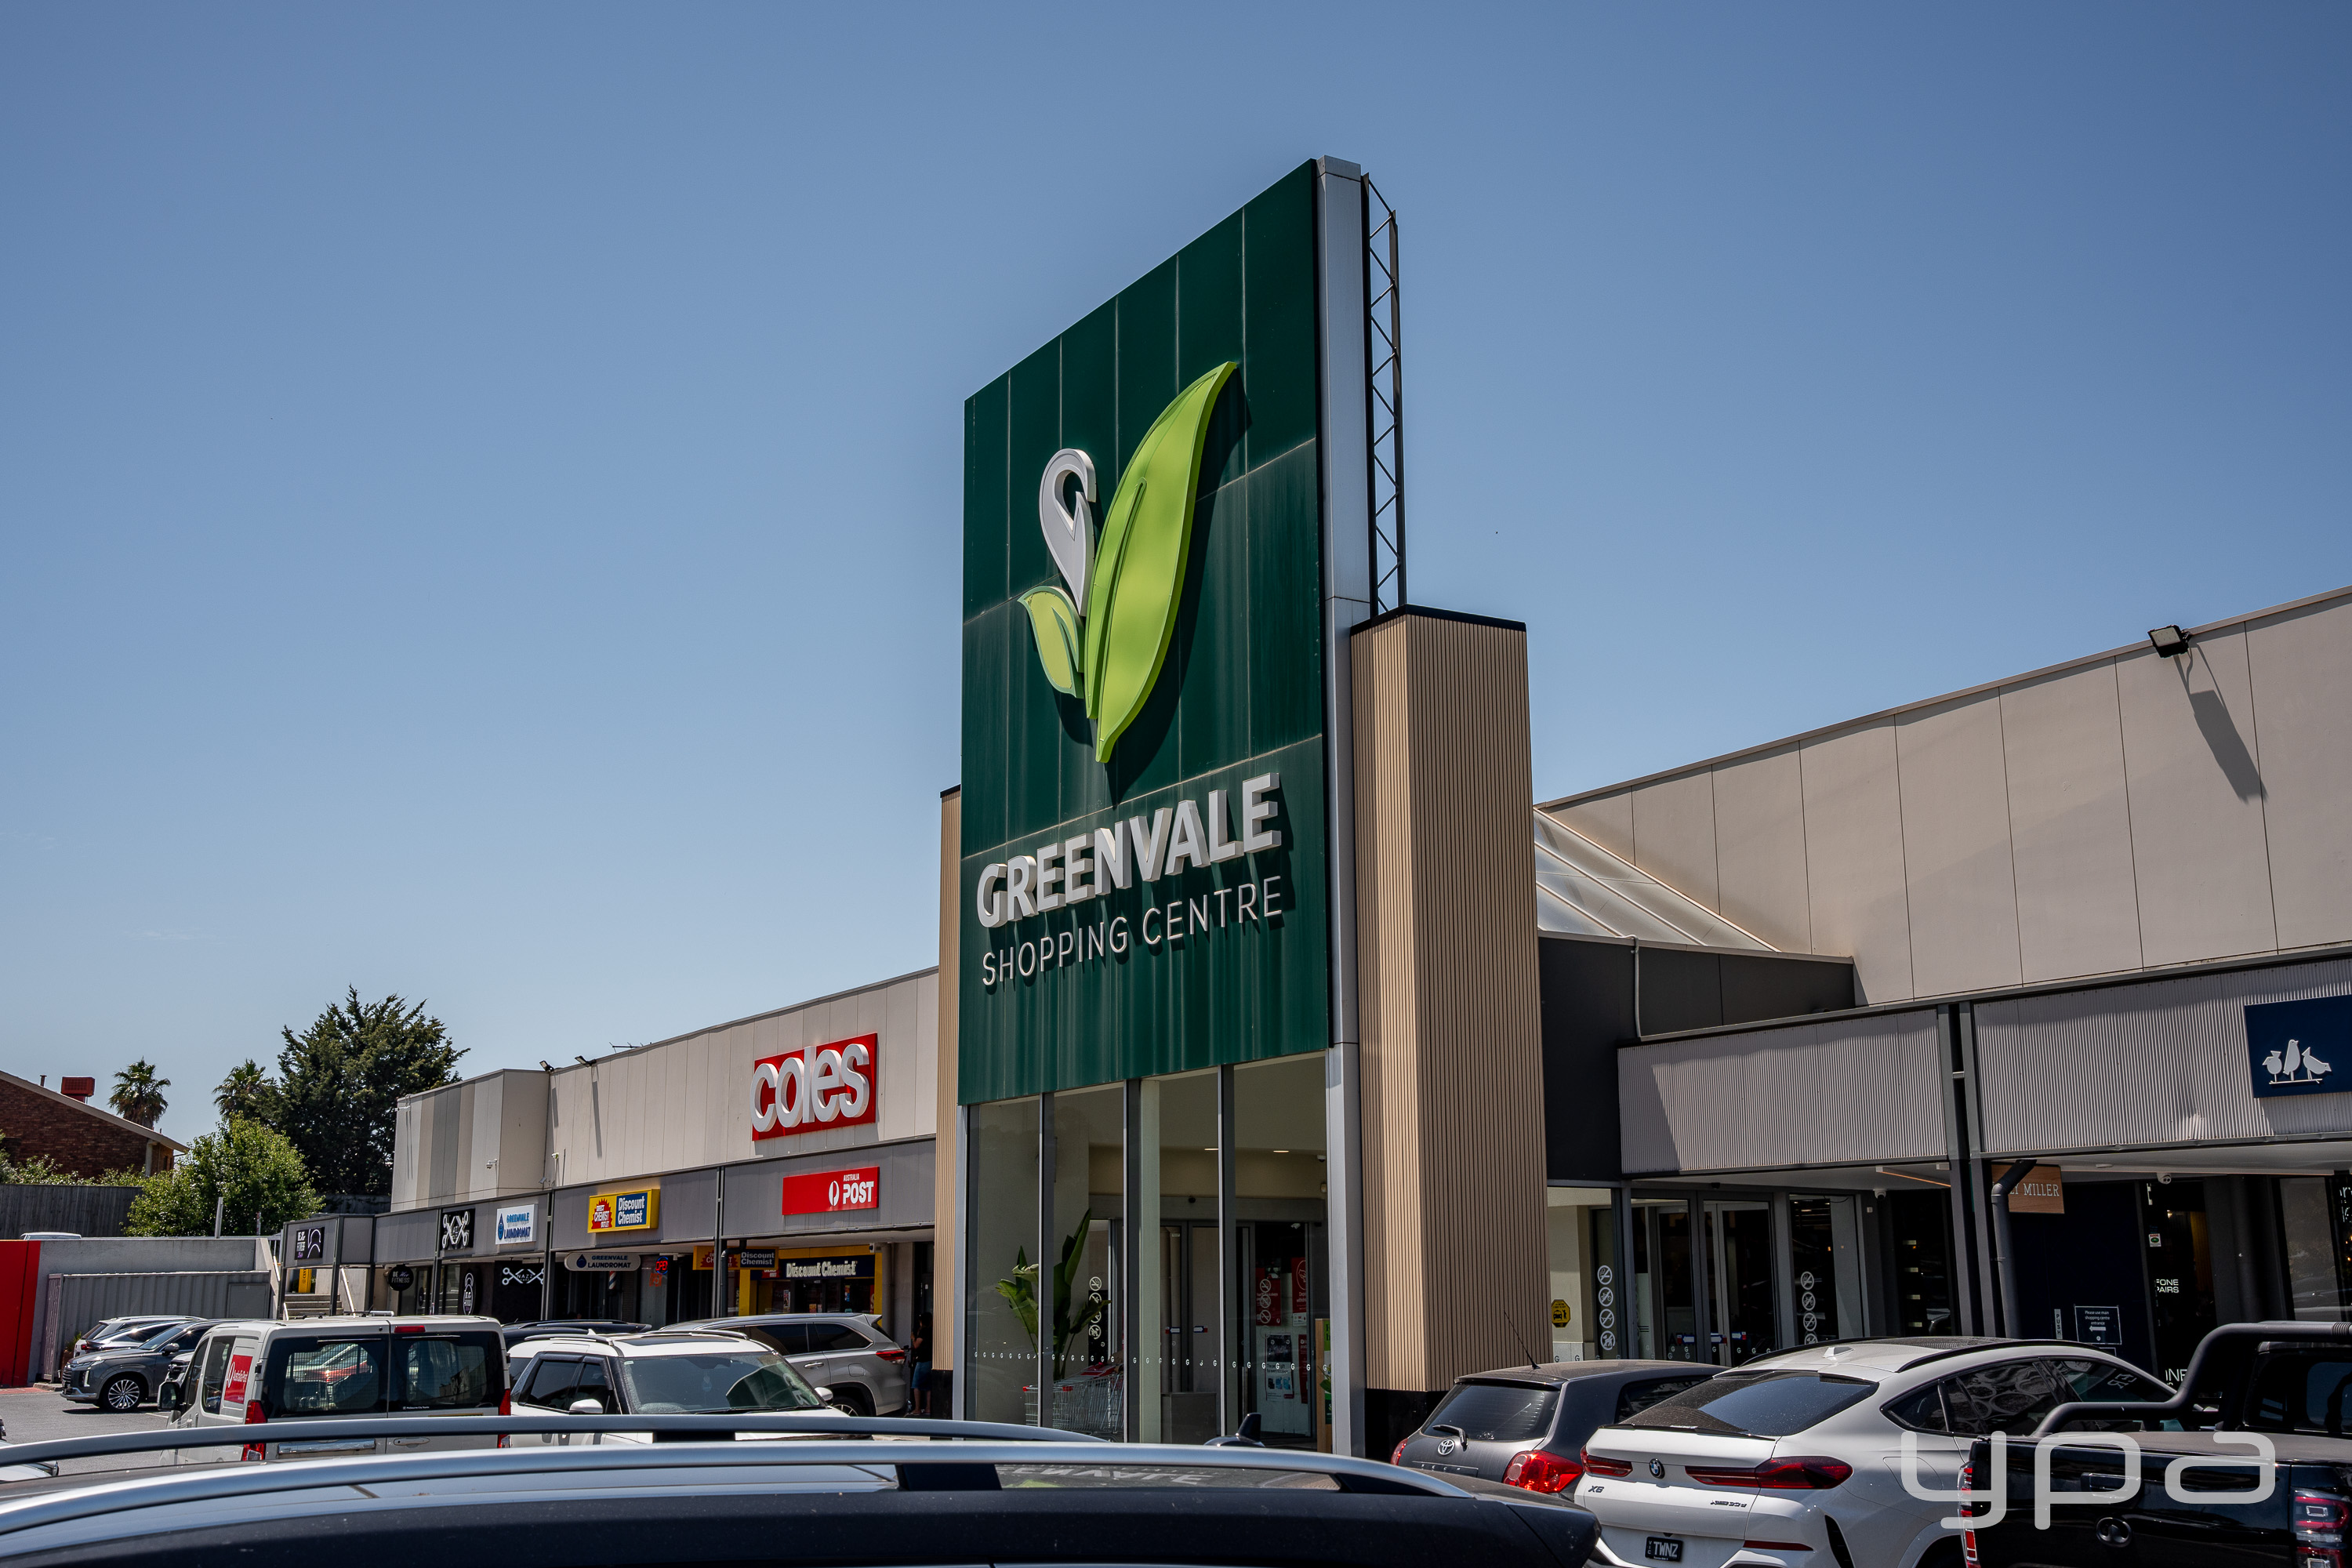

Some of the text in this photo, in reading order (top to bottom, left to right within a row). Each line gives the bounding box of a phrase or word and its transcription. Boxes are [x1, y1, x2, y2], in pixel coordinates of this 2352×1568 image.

[977, 773, 1282, 928] GREENVALE
[982, 876, 1282, 985] SHOPPING CENTRE
[750, 1044, 870, 1132] coles
[843, 1173, 860, 1181] AUSTRALIA
[843, 1181, 874, 1204] POST
[2023, 1183, 2060, 1196] MILLER
[618, 1196, 645, 1211] Discount
[506, 1212, 530, 1223] GREENVALE
[593, 1210, 610, 1222] CHEMIST
[618, 1210, 643, 1225] Chemist
[786, 1262, 822, 1278] Discount
[822, 1260, 856, 1277] Chemist
[1653, 1541, 1679, 1558] TWNZ
